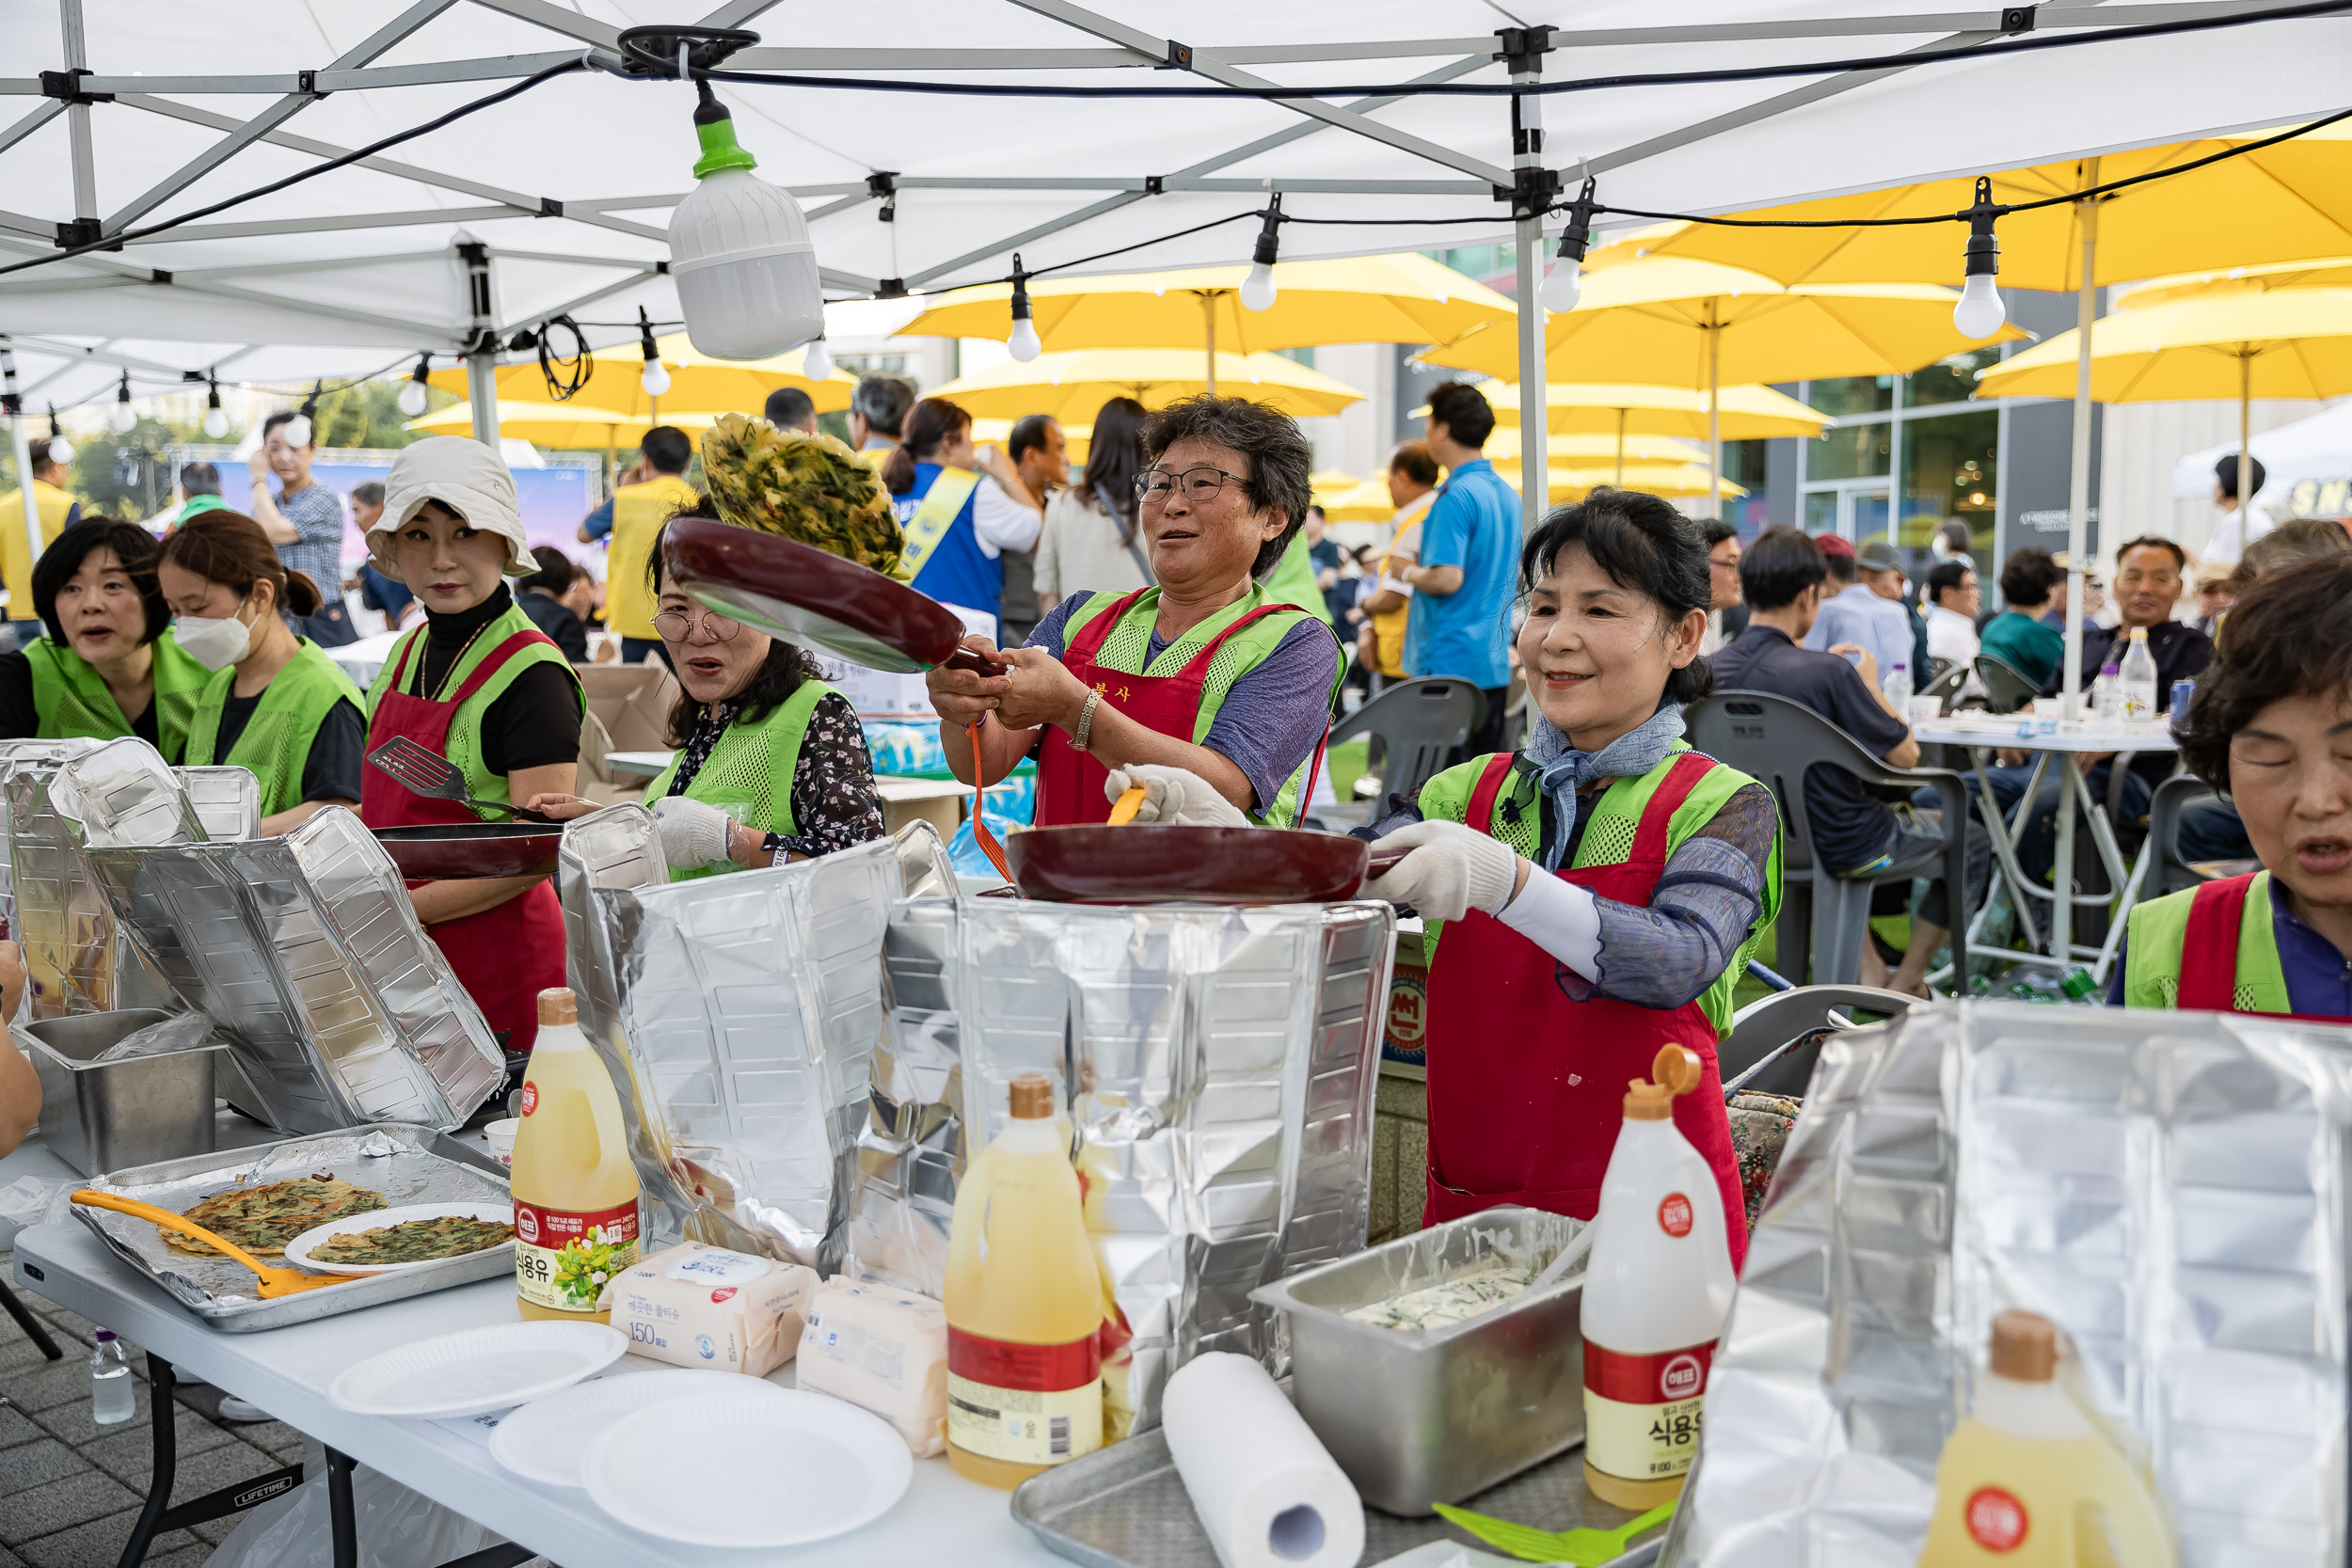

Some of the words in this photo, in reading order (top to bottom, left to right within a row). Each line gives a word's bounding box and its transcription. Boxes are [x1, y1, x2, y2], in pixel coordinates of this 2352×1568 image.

[1390, 992, 1420, 1030] 썬
[520, 1218, 535, 1232] 해표
[516, 1252, 548, 1282] 식용유
[628, 1301, 654, 1316] 깨끗한
[655, 1304, 680, 1321] 물티슈
[629, 1322, 655, 1345] 150
[1668, 1368, 1694, 1386] 해표
[241, 1480, 287, 1504] LIFETIME
